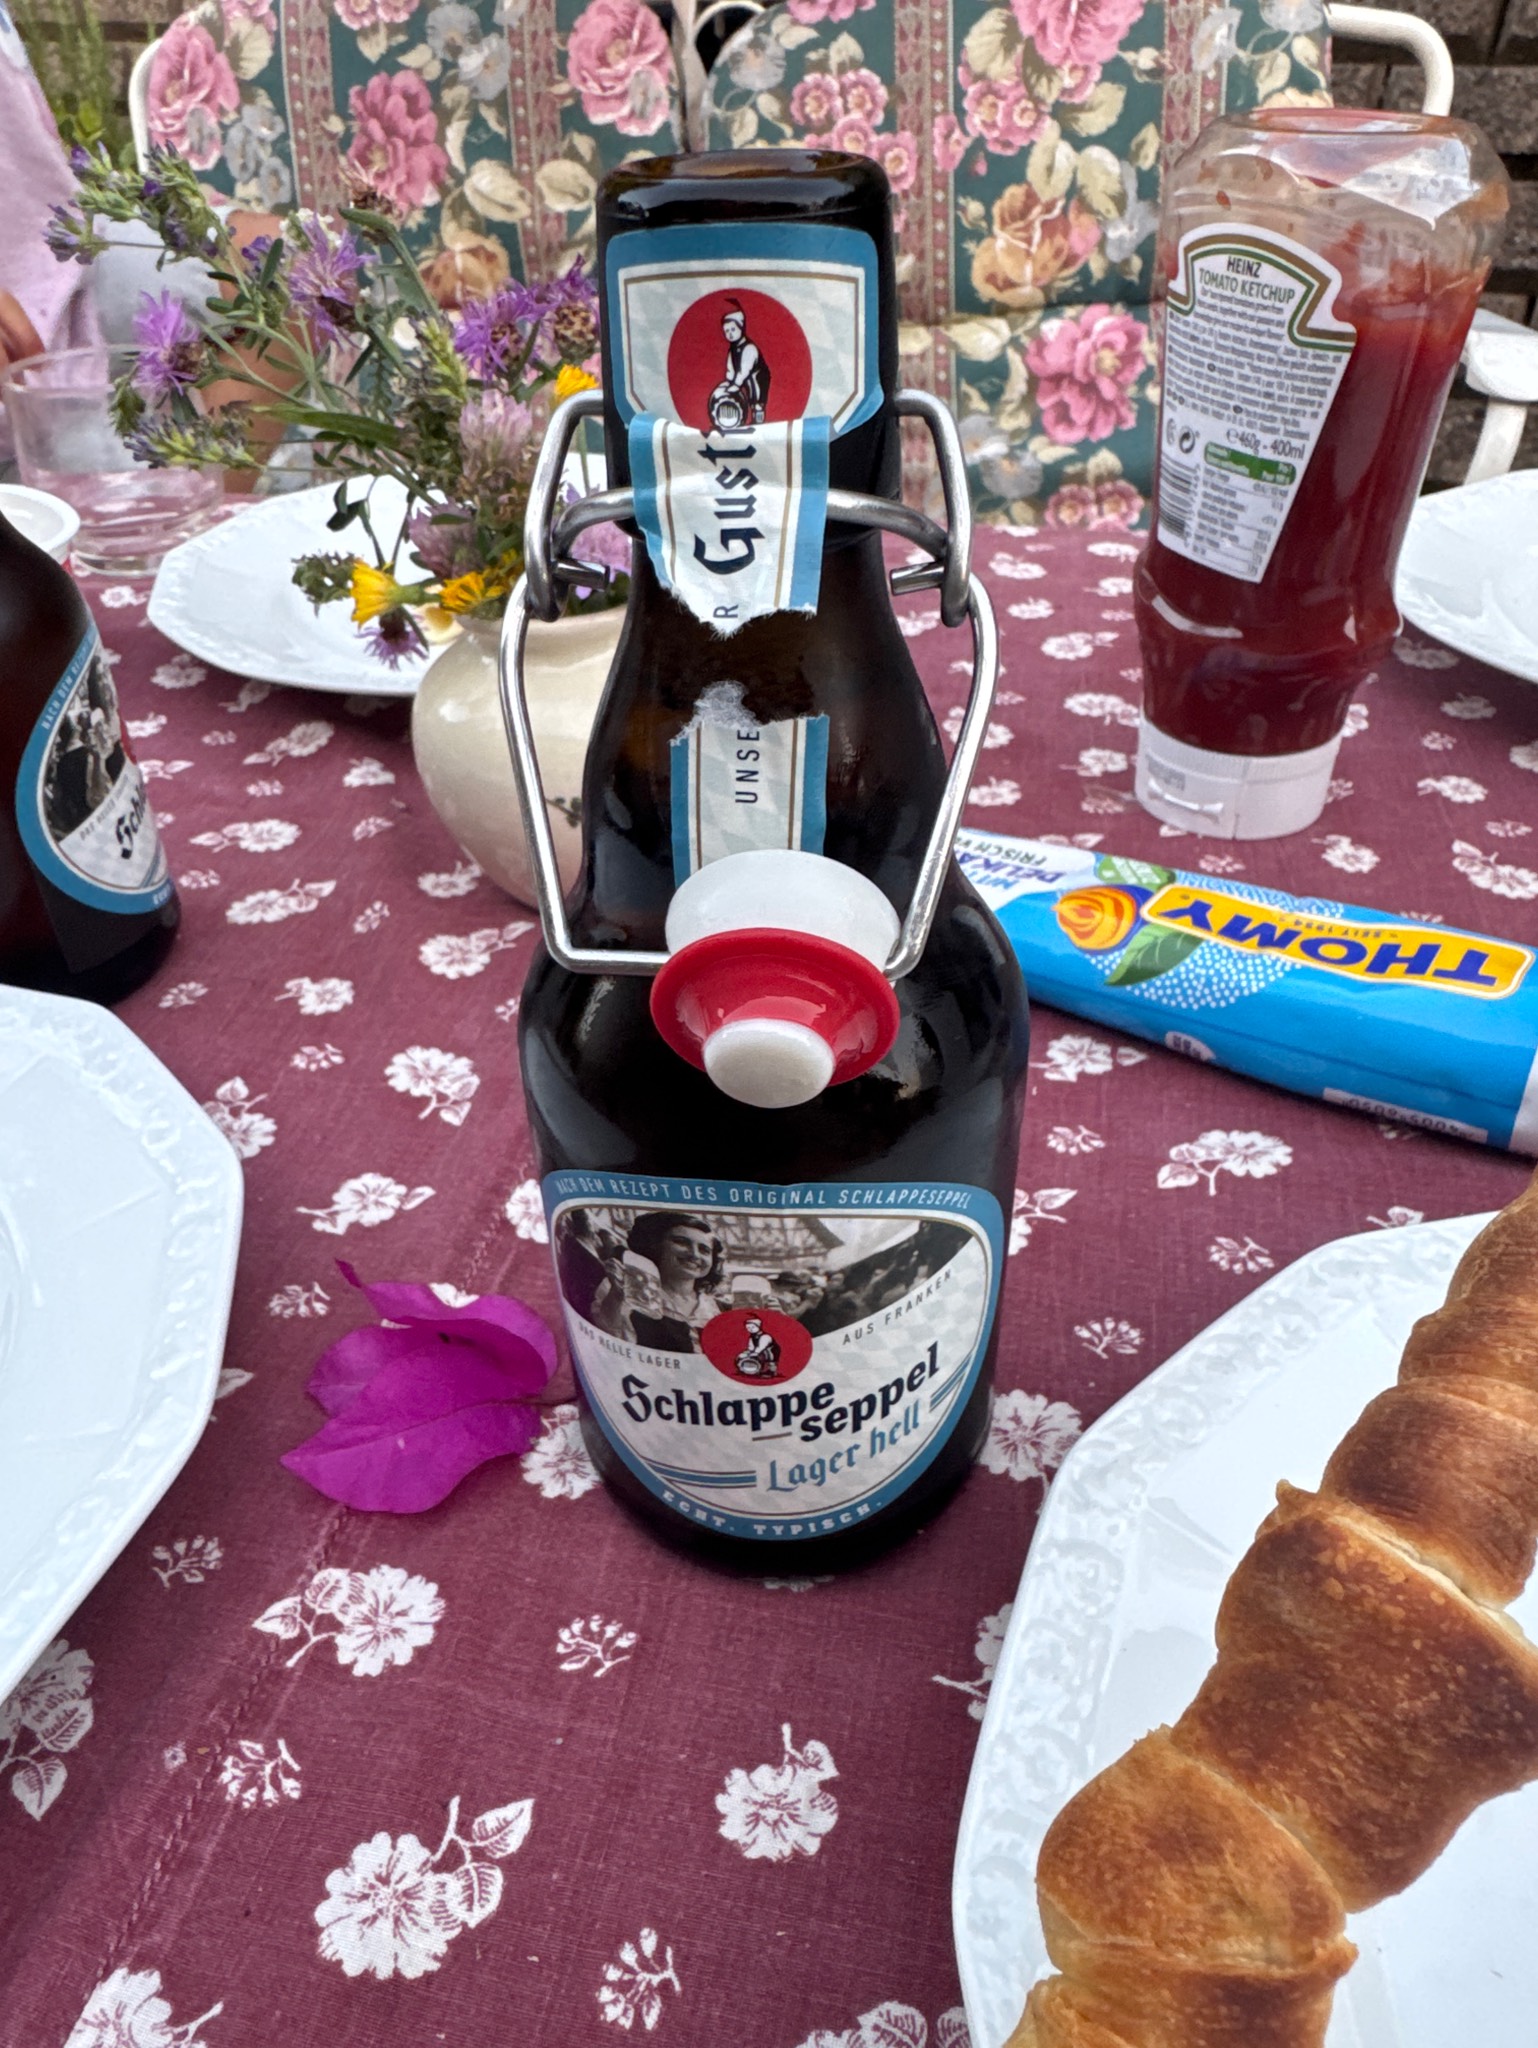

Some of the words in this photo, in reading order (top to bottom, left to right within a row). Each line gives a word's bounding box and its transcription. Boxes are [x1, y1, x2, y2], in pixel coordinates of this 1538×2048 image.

[1226, 256, 1262, 278] HEINZ
[1199, 268, 1239, 293] TOMATO
[1240, 280, 1296, 304] KETCHUP
[1270, 439, 1306, 460] 400ml
[955, 850, 1067, 884] DELIKA
[973, 841, 1048, 867] FRISCH
[1160, 899, 1498, 987] THOMY
[579, 1176, 606, 1194] DEM
[608, 1178, 671, 1199] REZEPT
[681, 1184, 718, 1201] DES
[729, 1187, 827, 1206] ORIGINAL
[838, 1188, 973, 1210] SCHLAPPESEPPEL
[842, 1322, 875, 1346] AUS
[884, 1268, 952, 1326] FRANKEN
[598, 1335, 632, 1359] HELLE
[638, 1351, 682, 1370] LAGER
[620, 1373, 836, 1433] Schlappe
[800, 1340, 941, 1443] seppel
[765, 1443, 861, 1493] Lager
[869, 1399, 920, 1459] hell
